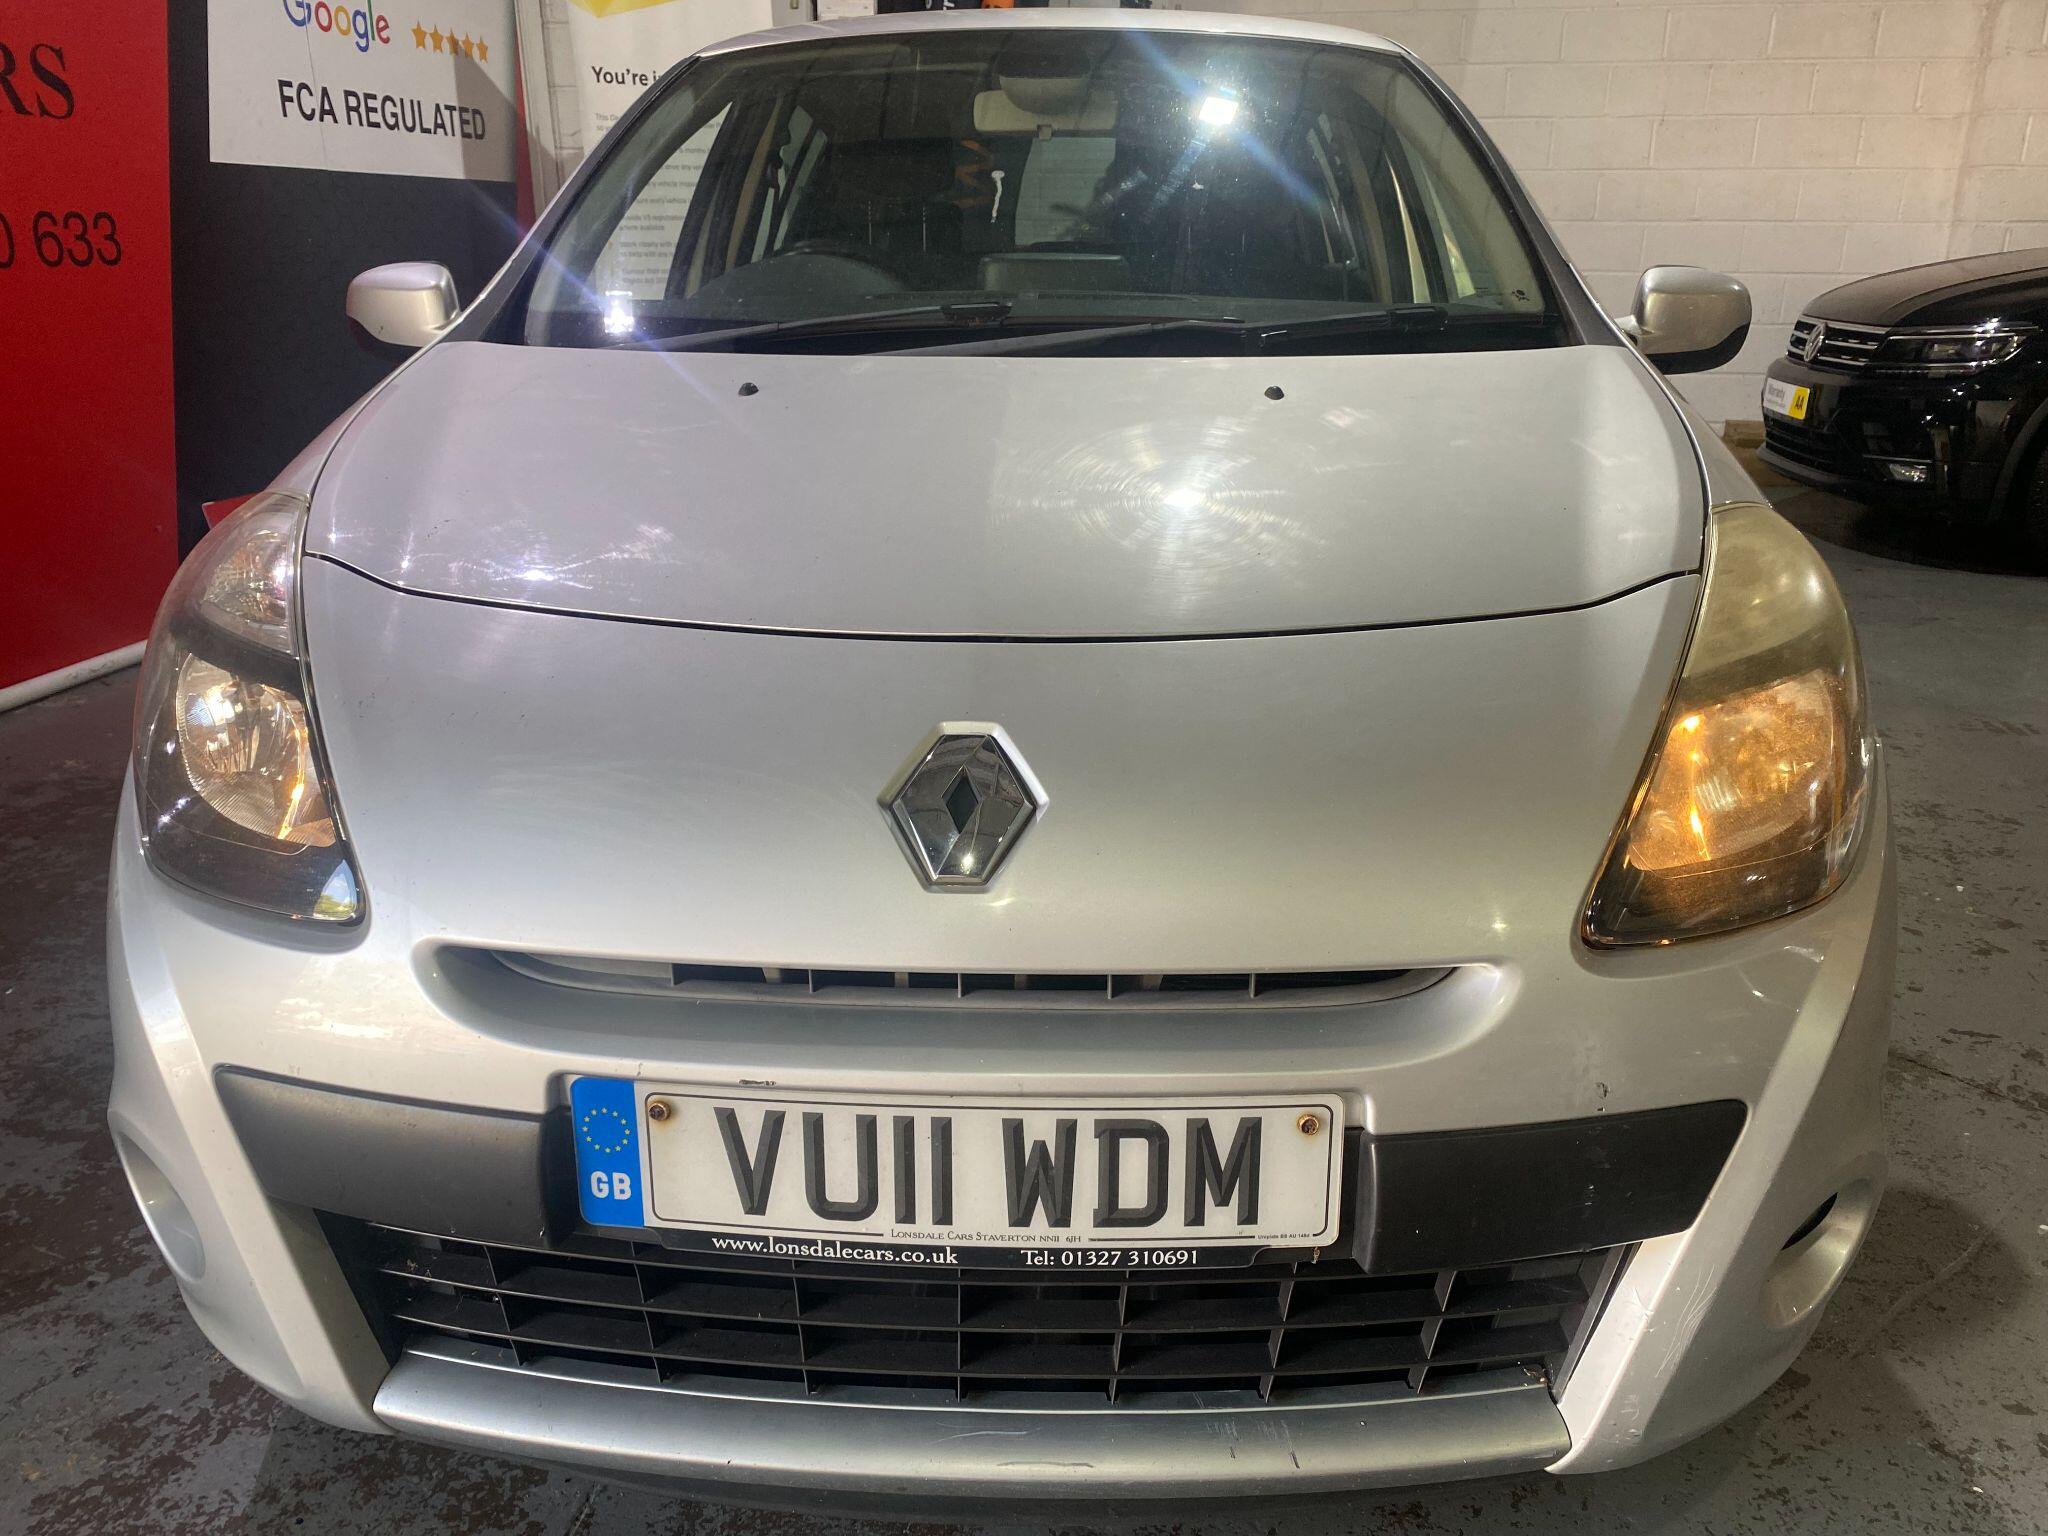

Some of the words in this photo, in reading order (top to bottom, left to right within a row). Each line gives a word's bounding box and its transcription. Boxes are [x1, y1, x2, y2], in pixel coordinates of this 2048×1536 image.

[283, 0, 390, 52] Google
[591, 66, 648, 86] You're
[277, 79, 338, 124] FCA
[343, 89, 486, 140] REGULATED
[33, 210, 122, 267] 633
[713, 1106, 953, 1226] VU11
[1002, 1116, 1262, 1228] WDM
[590, 1171, 632, 1200] GB
[712, 1236, 958, 1265] www.lonsdalecars.co.uk
[976, 1232, 1037, 1242] STAVERTON
[1020, 1250, 1055, 1265] Tel:
[1061, 1250, 1121, 1266] 01327
[1127, 1249, 1198, 1266] 310691
